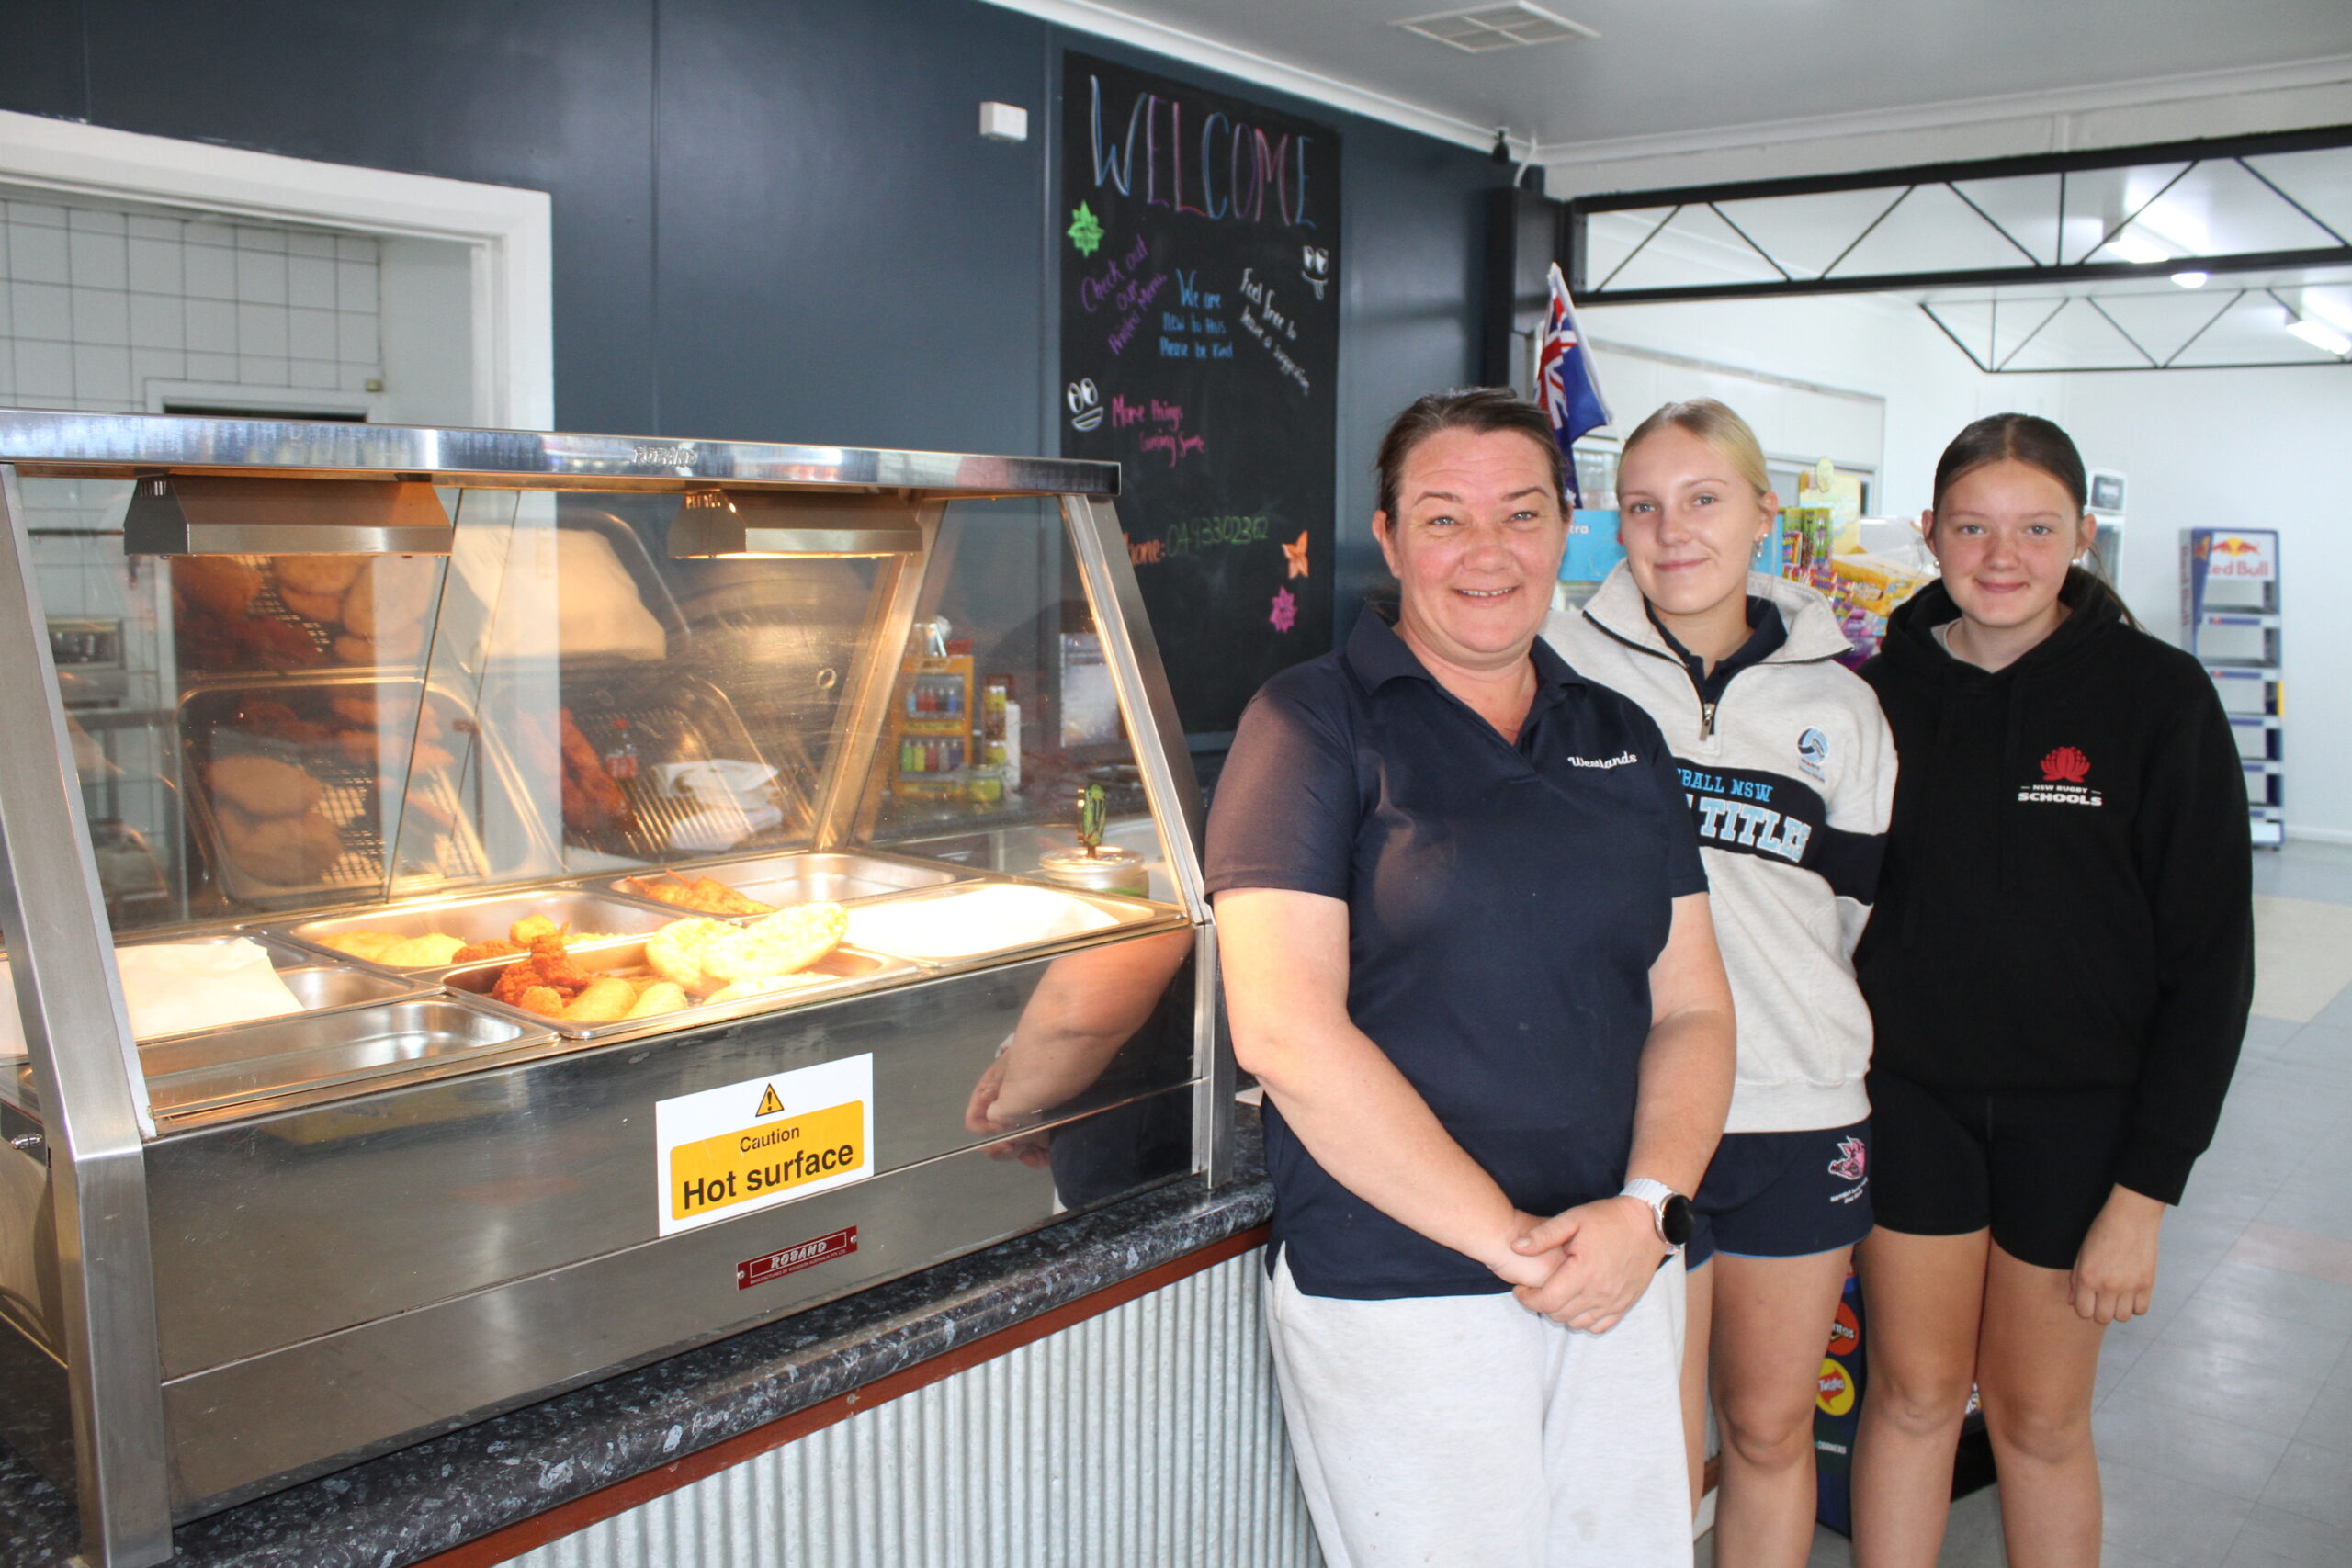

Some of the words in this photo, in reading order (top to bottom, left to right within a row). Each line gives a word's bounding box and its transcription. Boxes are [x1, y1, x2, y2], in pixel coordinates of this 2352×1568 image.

[1091, 74, 1317, 228] WELCOME
[1176, 268, 1199, 309] We
[1203, 292, 1221, 309] are
[1191, 313, 1202, 333] to
[1286, 320, 1297, 340] to
[1194, 341, 1207, 358] be
[1112, 394, 1145, 427] More
[2237, 561, 2268, 576] Bull
[1567, 750, 1637, 769] Westlands
[1677, 768, 1725, 794] BALL
[1730, 779, 1774, 802] NSW
[2056, 785, 2088, 794] RUGBY
[2018, 792, 2103, 807] SCHOOLS
[740, 1126, 800, 1152] Caution
[684, 1171, 736, 1210] Hot
[746, 1144, 854, 1191] surface
[771, 1242, 827, 1269] ROBAND
